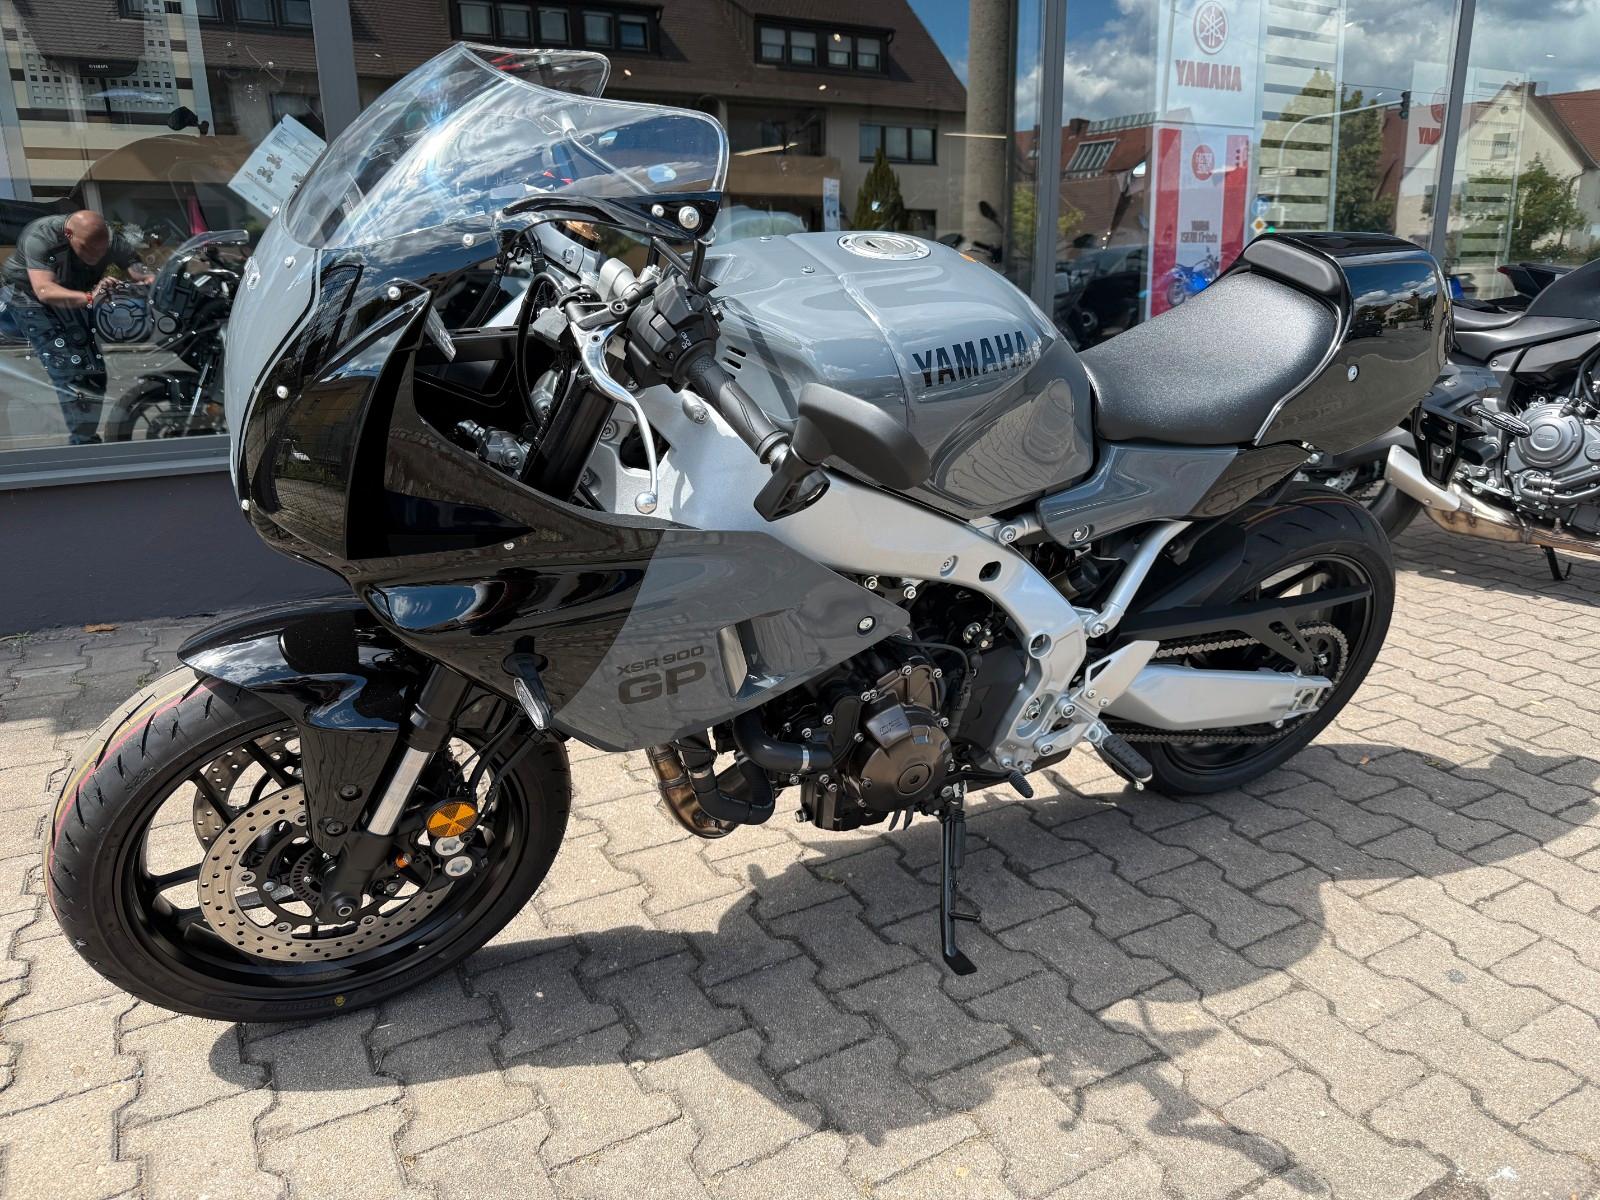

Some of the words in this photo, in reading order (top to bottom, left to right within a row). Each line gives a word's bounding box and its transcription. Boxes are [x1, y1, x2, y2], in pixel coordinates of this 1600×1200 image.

[1175, 59, 1242, 91] YAMAHA
[911, 331, 1032, 387] YAMAHA
[616, 658, 660, 676] XSR
[661, 645, 705, 665] 900
[618, 661, 706, 704] GP
